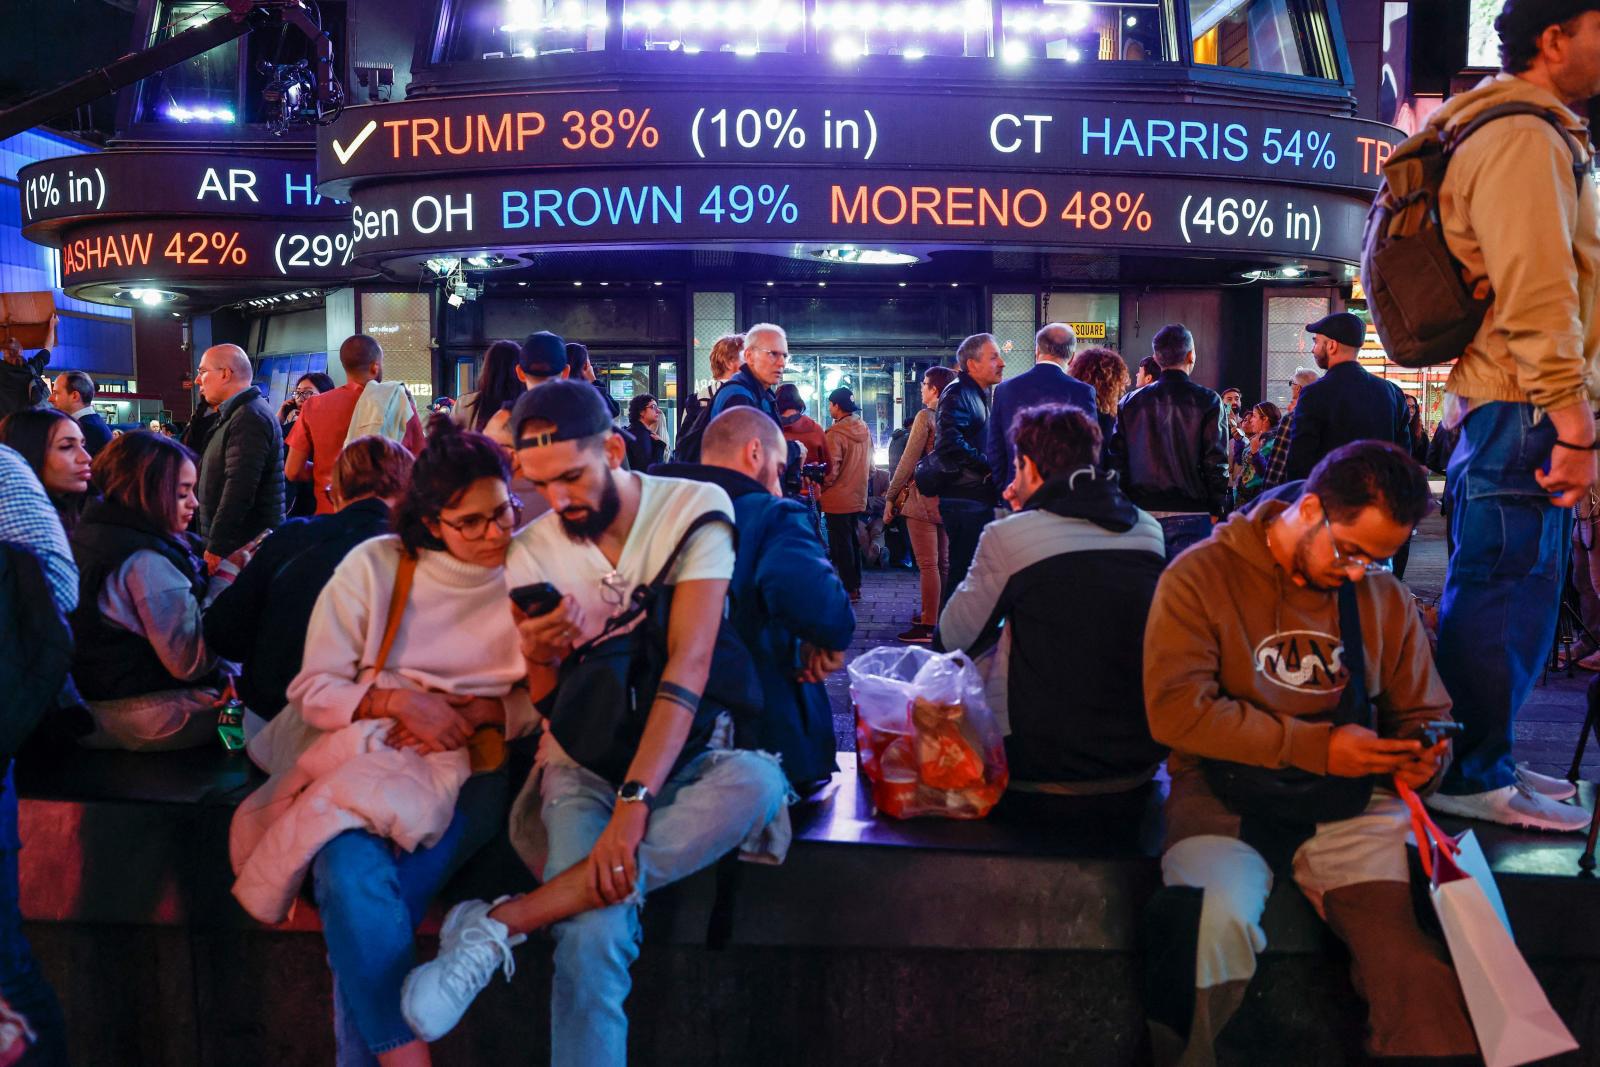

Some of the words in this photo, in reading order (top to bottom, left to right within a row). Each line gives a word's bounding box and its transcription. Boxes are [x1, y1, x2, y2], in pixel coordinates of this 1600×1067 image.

[384, 112, 546, 158] TRUMP
[561, 108, 659, 150] 38%
[691, 107, 806, 158] (10%
[824, 109, 877, 160] in)
[990, 113, 1053, 154] CT
[1082, 116, 1249, 162] HARRIS
[1261, 127, 1336, 170] 54%
[1356, 136, 1397, 176] TR
[25, 172, 60, 220] (1%
[68, 167, 106, 210] in)
[196, 167, 260, 203] AR
[353, 205, 399, 243] Sen
[411, 193, 473, 234] OH
[502, 185, 683, 229] BROWN
[699, 184, 799, 225] 49%
[831, 184, 1048, 228] MORENO
[1061, 191, 1152, 232] 48%
[1179, 194, 1274, 244] (46%
[1286, 202, 1322, 252] in)
[164, 231, 247, 265] 42%
[274, 233, 354, 275] (29%
[1075, 324, 1104, 336] SQUARE
